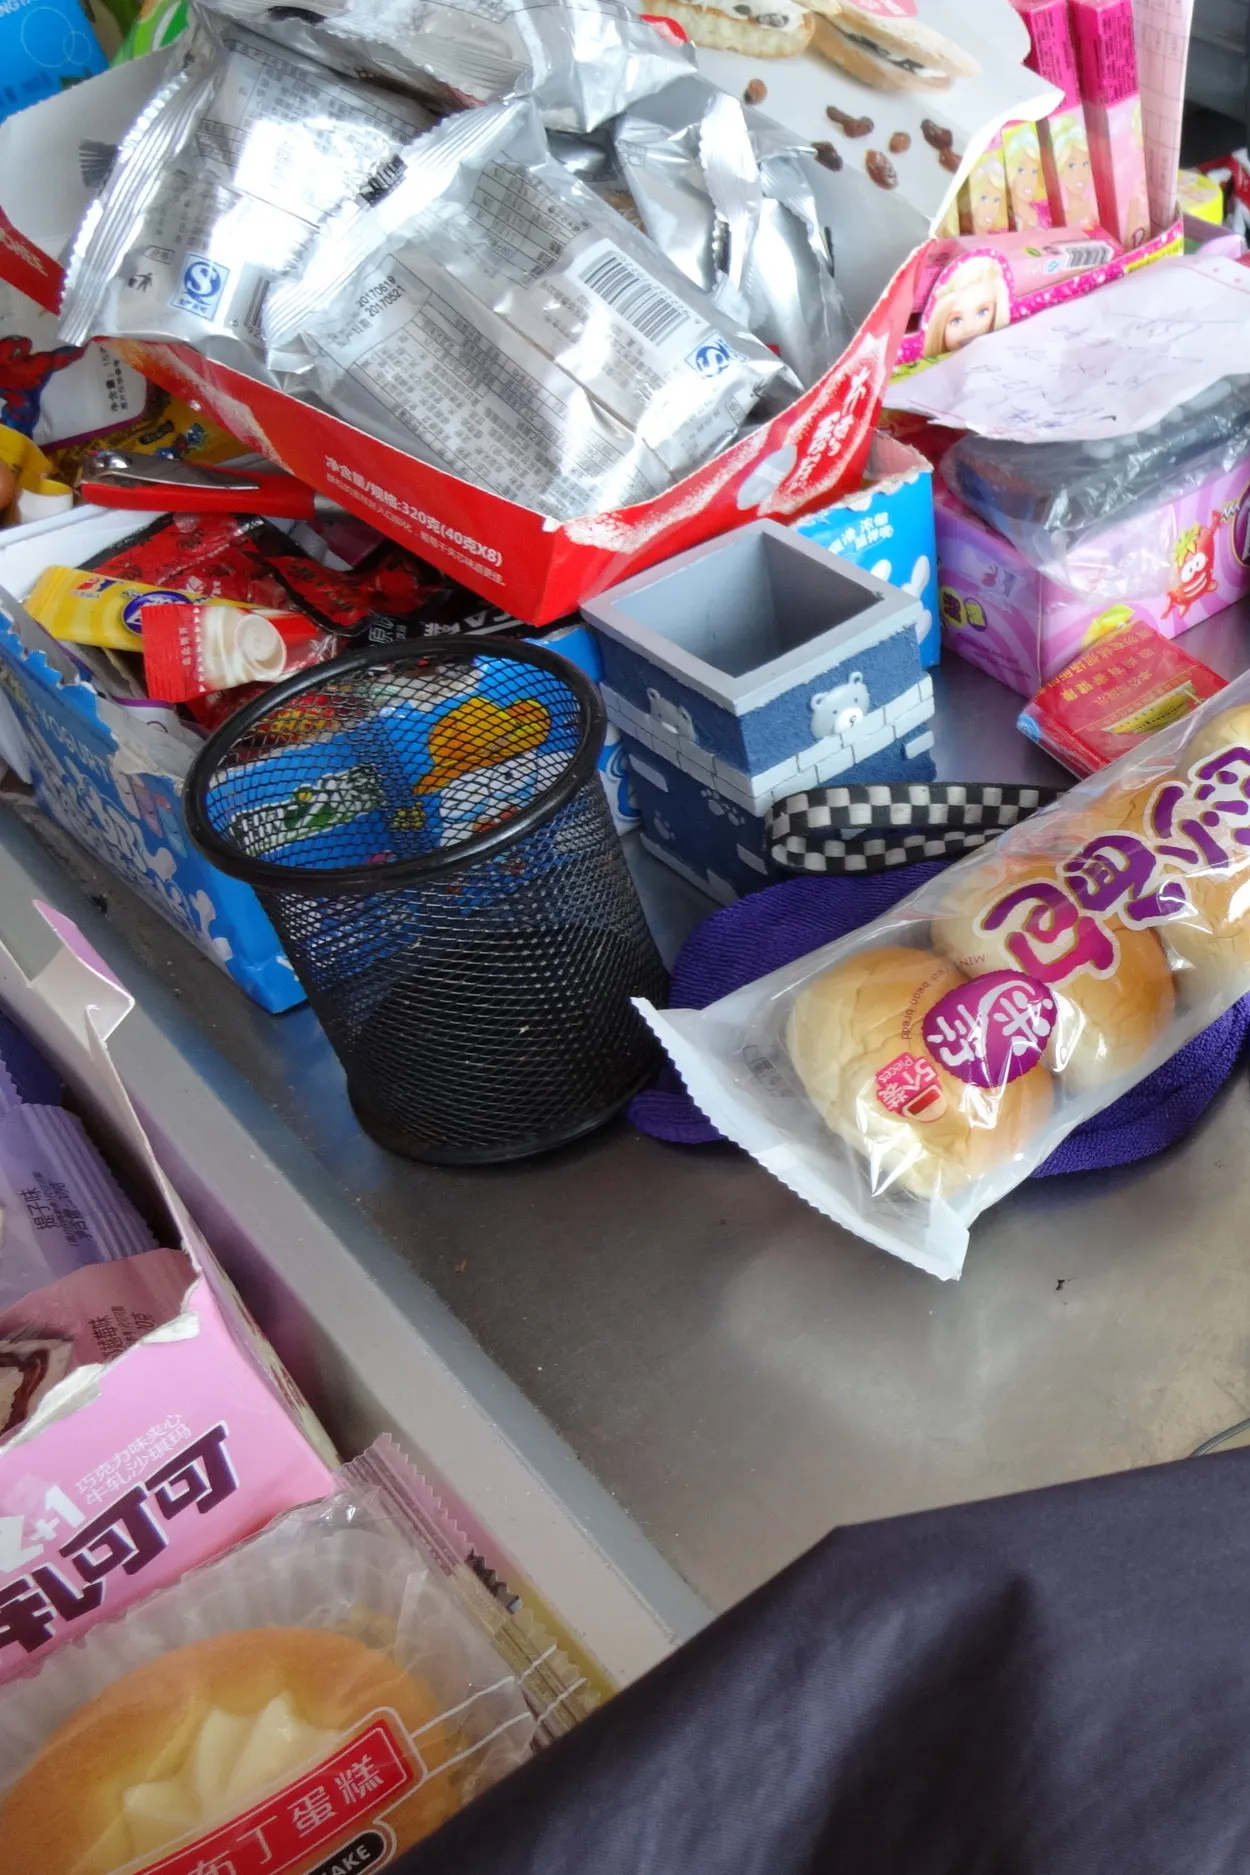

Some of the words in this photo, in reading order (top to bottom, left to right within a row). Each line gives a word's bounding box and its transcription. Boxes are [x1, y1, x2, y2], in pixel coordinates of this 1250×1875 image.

[912, 981, 932, 1007] bean
[901, 1007, 916, 1041] bread
[926, 980, 1054, 1067] 迷你
[879, 1055, 914, 1084] Pieces
[322, 1844, 371, 1875] AKE
